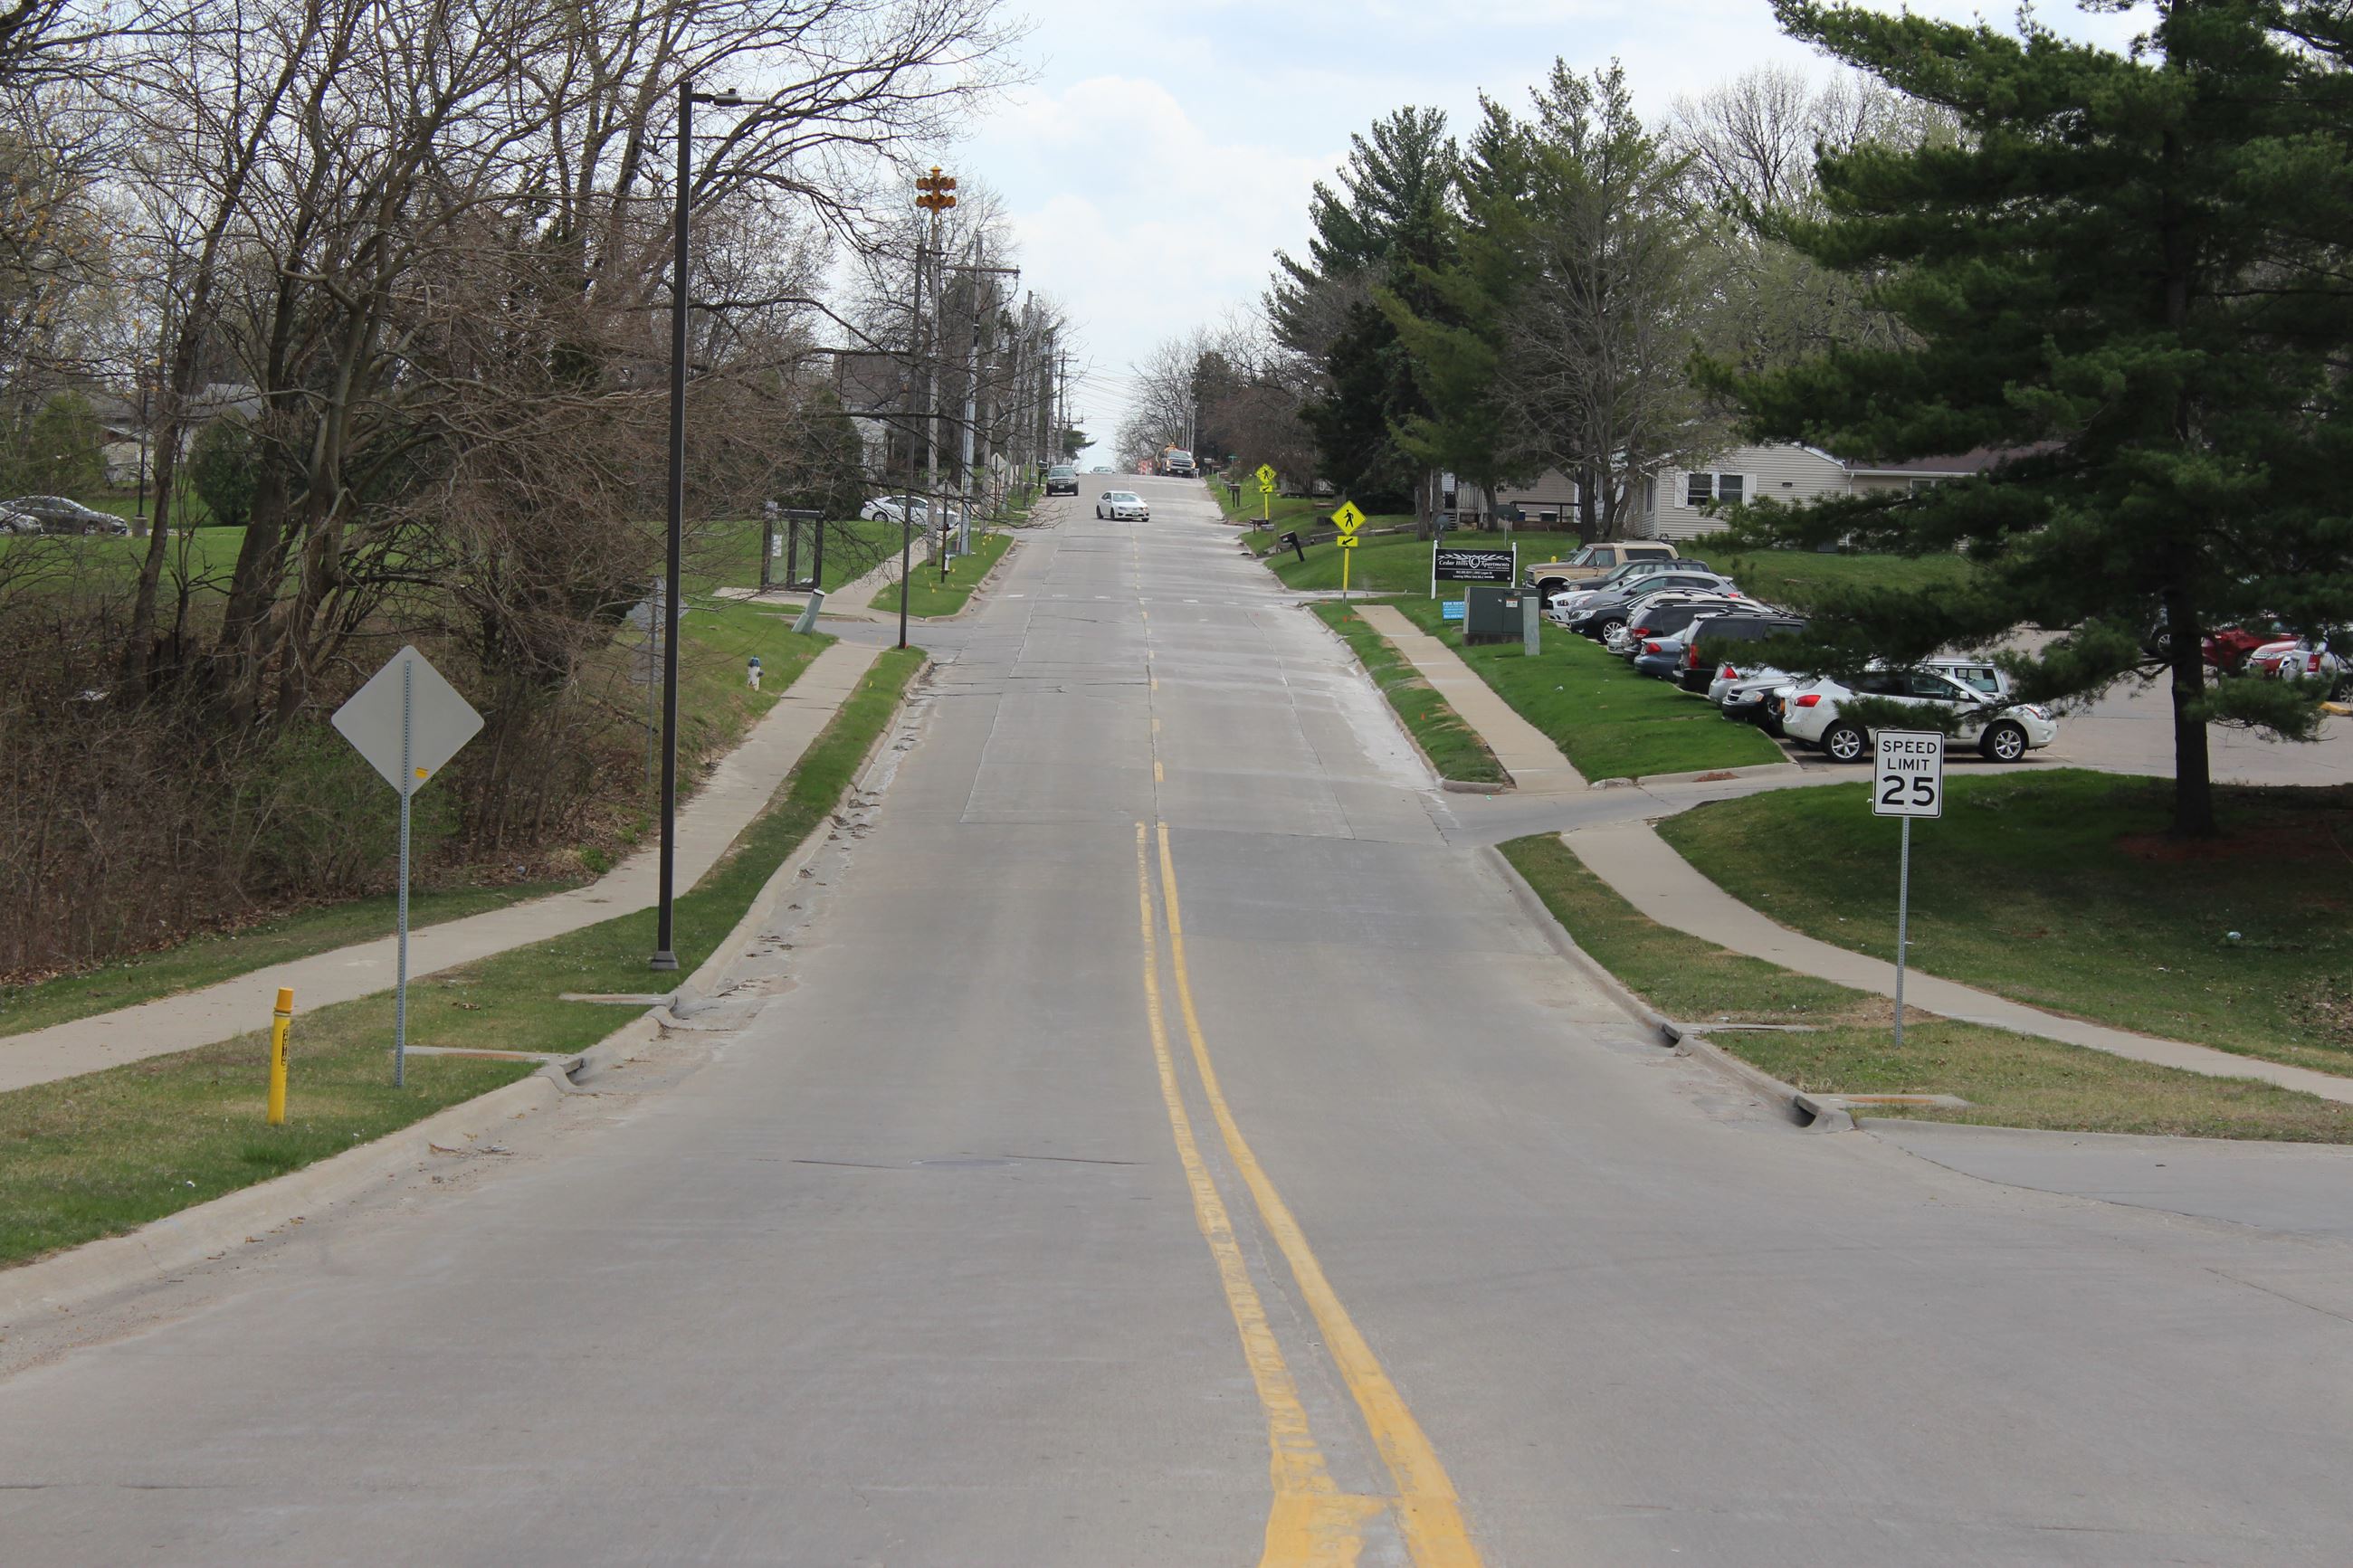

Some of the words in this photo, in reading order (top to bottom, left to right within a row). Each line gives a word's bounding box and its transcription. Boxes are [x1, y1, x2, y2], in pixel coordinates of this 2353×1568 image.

[1882, 740, 1937, 754] SPEED
[1887, 757, 1929, 771] LIMIT
[1881, 774, 1935, 806] 25
